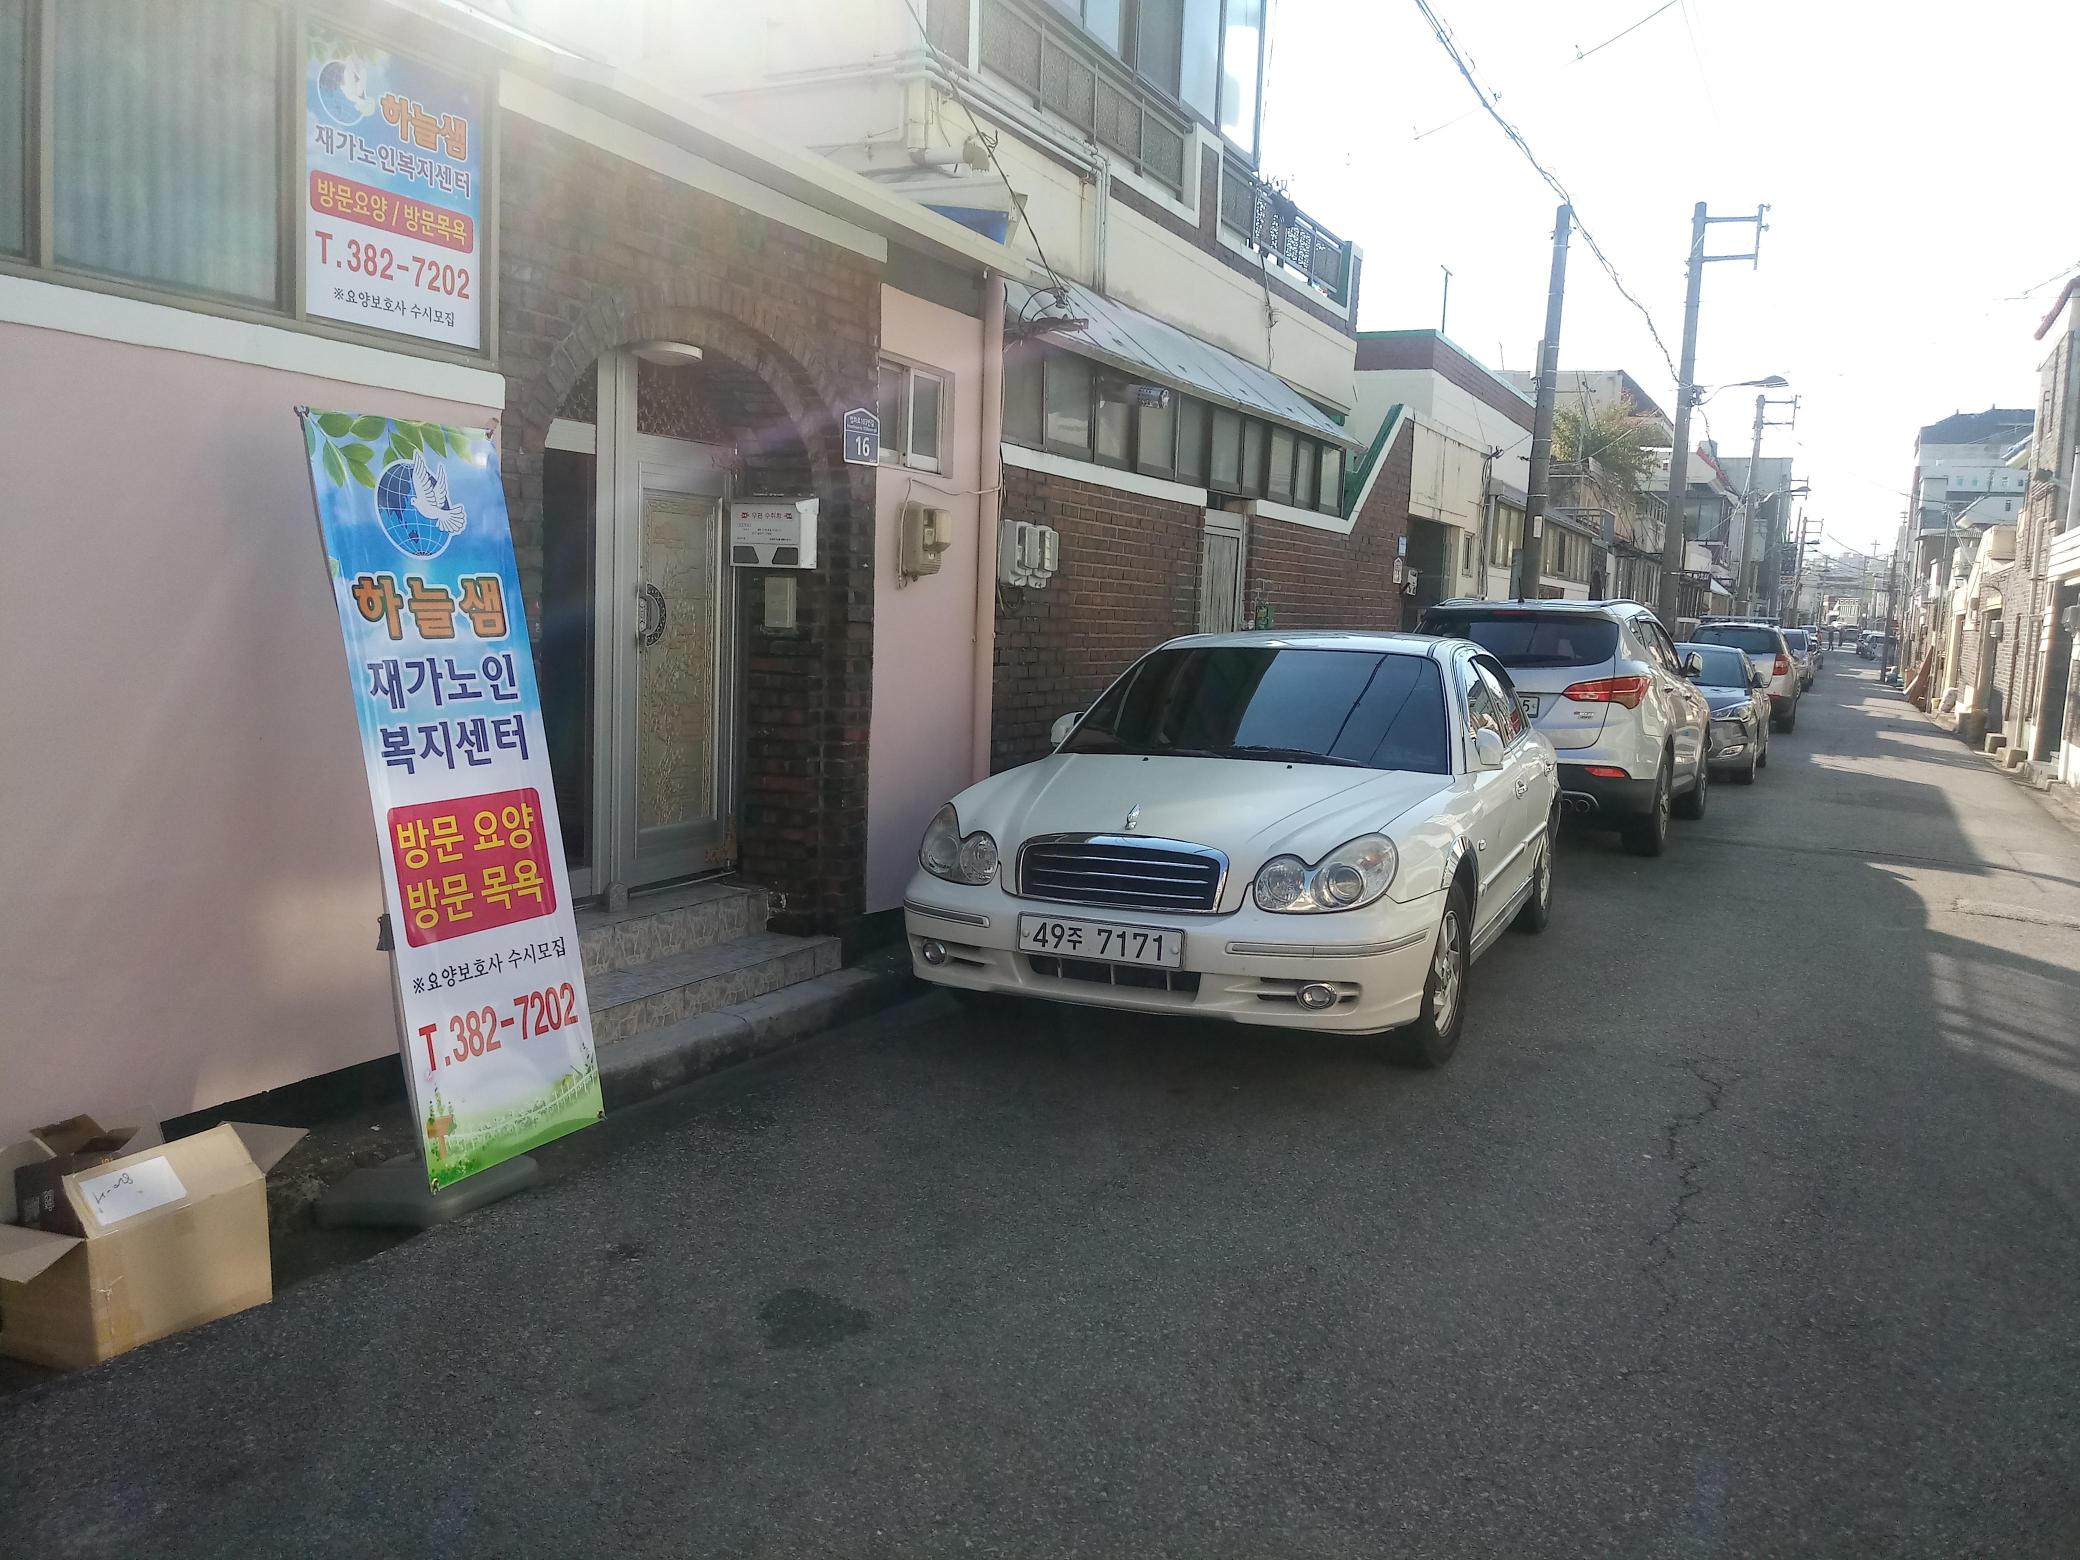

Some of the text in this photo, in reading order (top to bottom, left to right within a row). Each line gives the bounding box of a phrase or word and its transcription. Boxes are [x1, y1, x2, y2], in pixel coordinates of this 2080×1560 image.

[380, 93, 467, 161] 하늘샘
[315, 125, 471, 198] 재가노인복지센터
[316, 178, 389, 223] 방문요양
[404, 204, 467, 245] 방문목욕
[315, 230, 470, 300] T.382-7202
[410, 303, 455, 327] 수시모집
[855, 435, 870, 457] 16
[351, 574, 507, 641] 하늘샘
[367, 653, 519, 710] 재가노인
[380, 714, 529, 775] 복지센터
[396, 802, 534, 869] 방문 요양
[406, 858, 545, 929] 방문 목욕
[508, 936, 567, 969] 수시모집
[1032, 922, 1163, 961] 49주 7171
[418, 981, 578, 1072] T.382-7202
